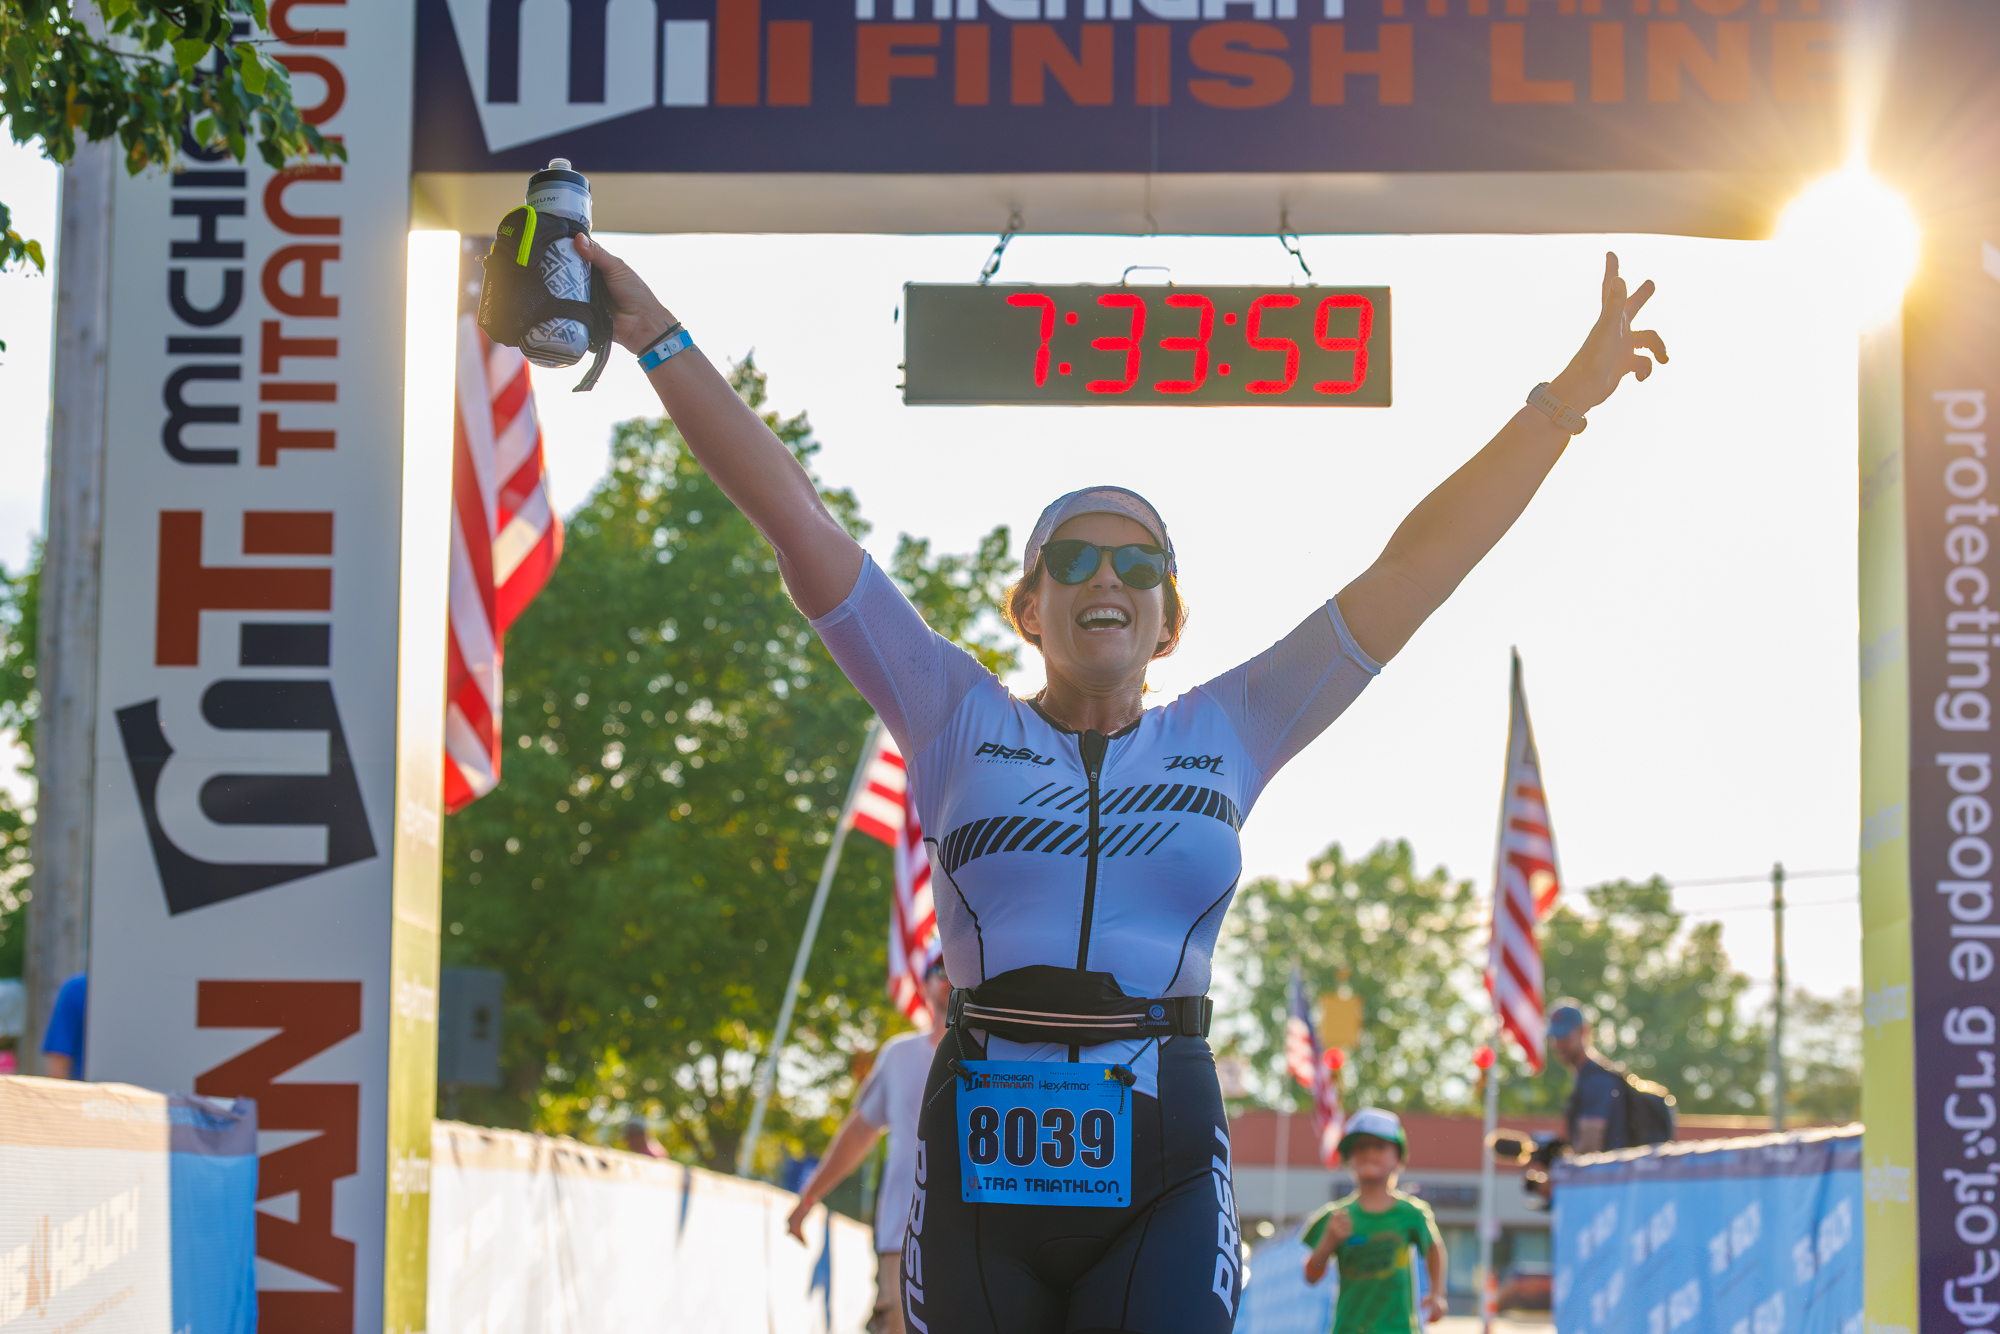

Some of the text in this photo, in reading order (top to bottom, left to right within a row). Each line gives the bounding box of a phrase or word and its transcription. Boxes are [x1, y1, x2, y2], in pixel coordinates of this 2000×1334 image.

[856, 20, 1840, 108] FINISH LINE
[161, 0, 247, 466] MICHI
[1007, 293, 1374, 394] 7:33:59
[1932, 389, 1999, 731] protecting
[974, 741, 1056, 766] PRSU
[1935, 753, 2000, 982] people
[992, 1073, 1034, 1082] MICHIGAN
[992, 1081, 1034, 1090] TITANIUM
[1038, 1080, 1091, 1093] HexArmor
[968, 1105, 1116, 1169] 8039
[968, 1175, 1120, 1194] ULTRA TRIATHLON
